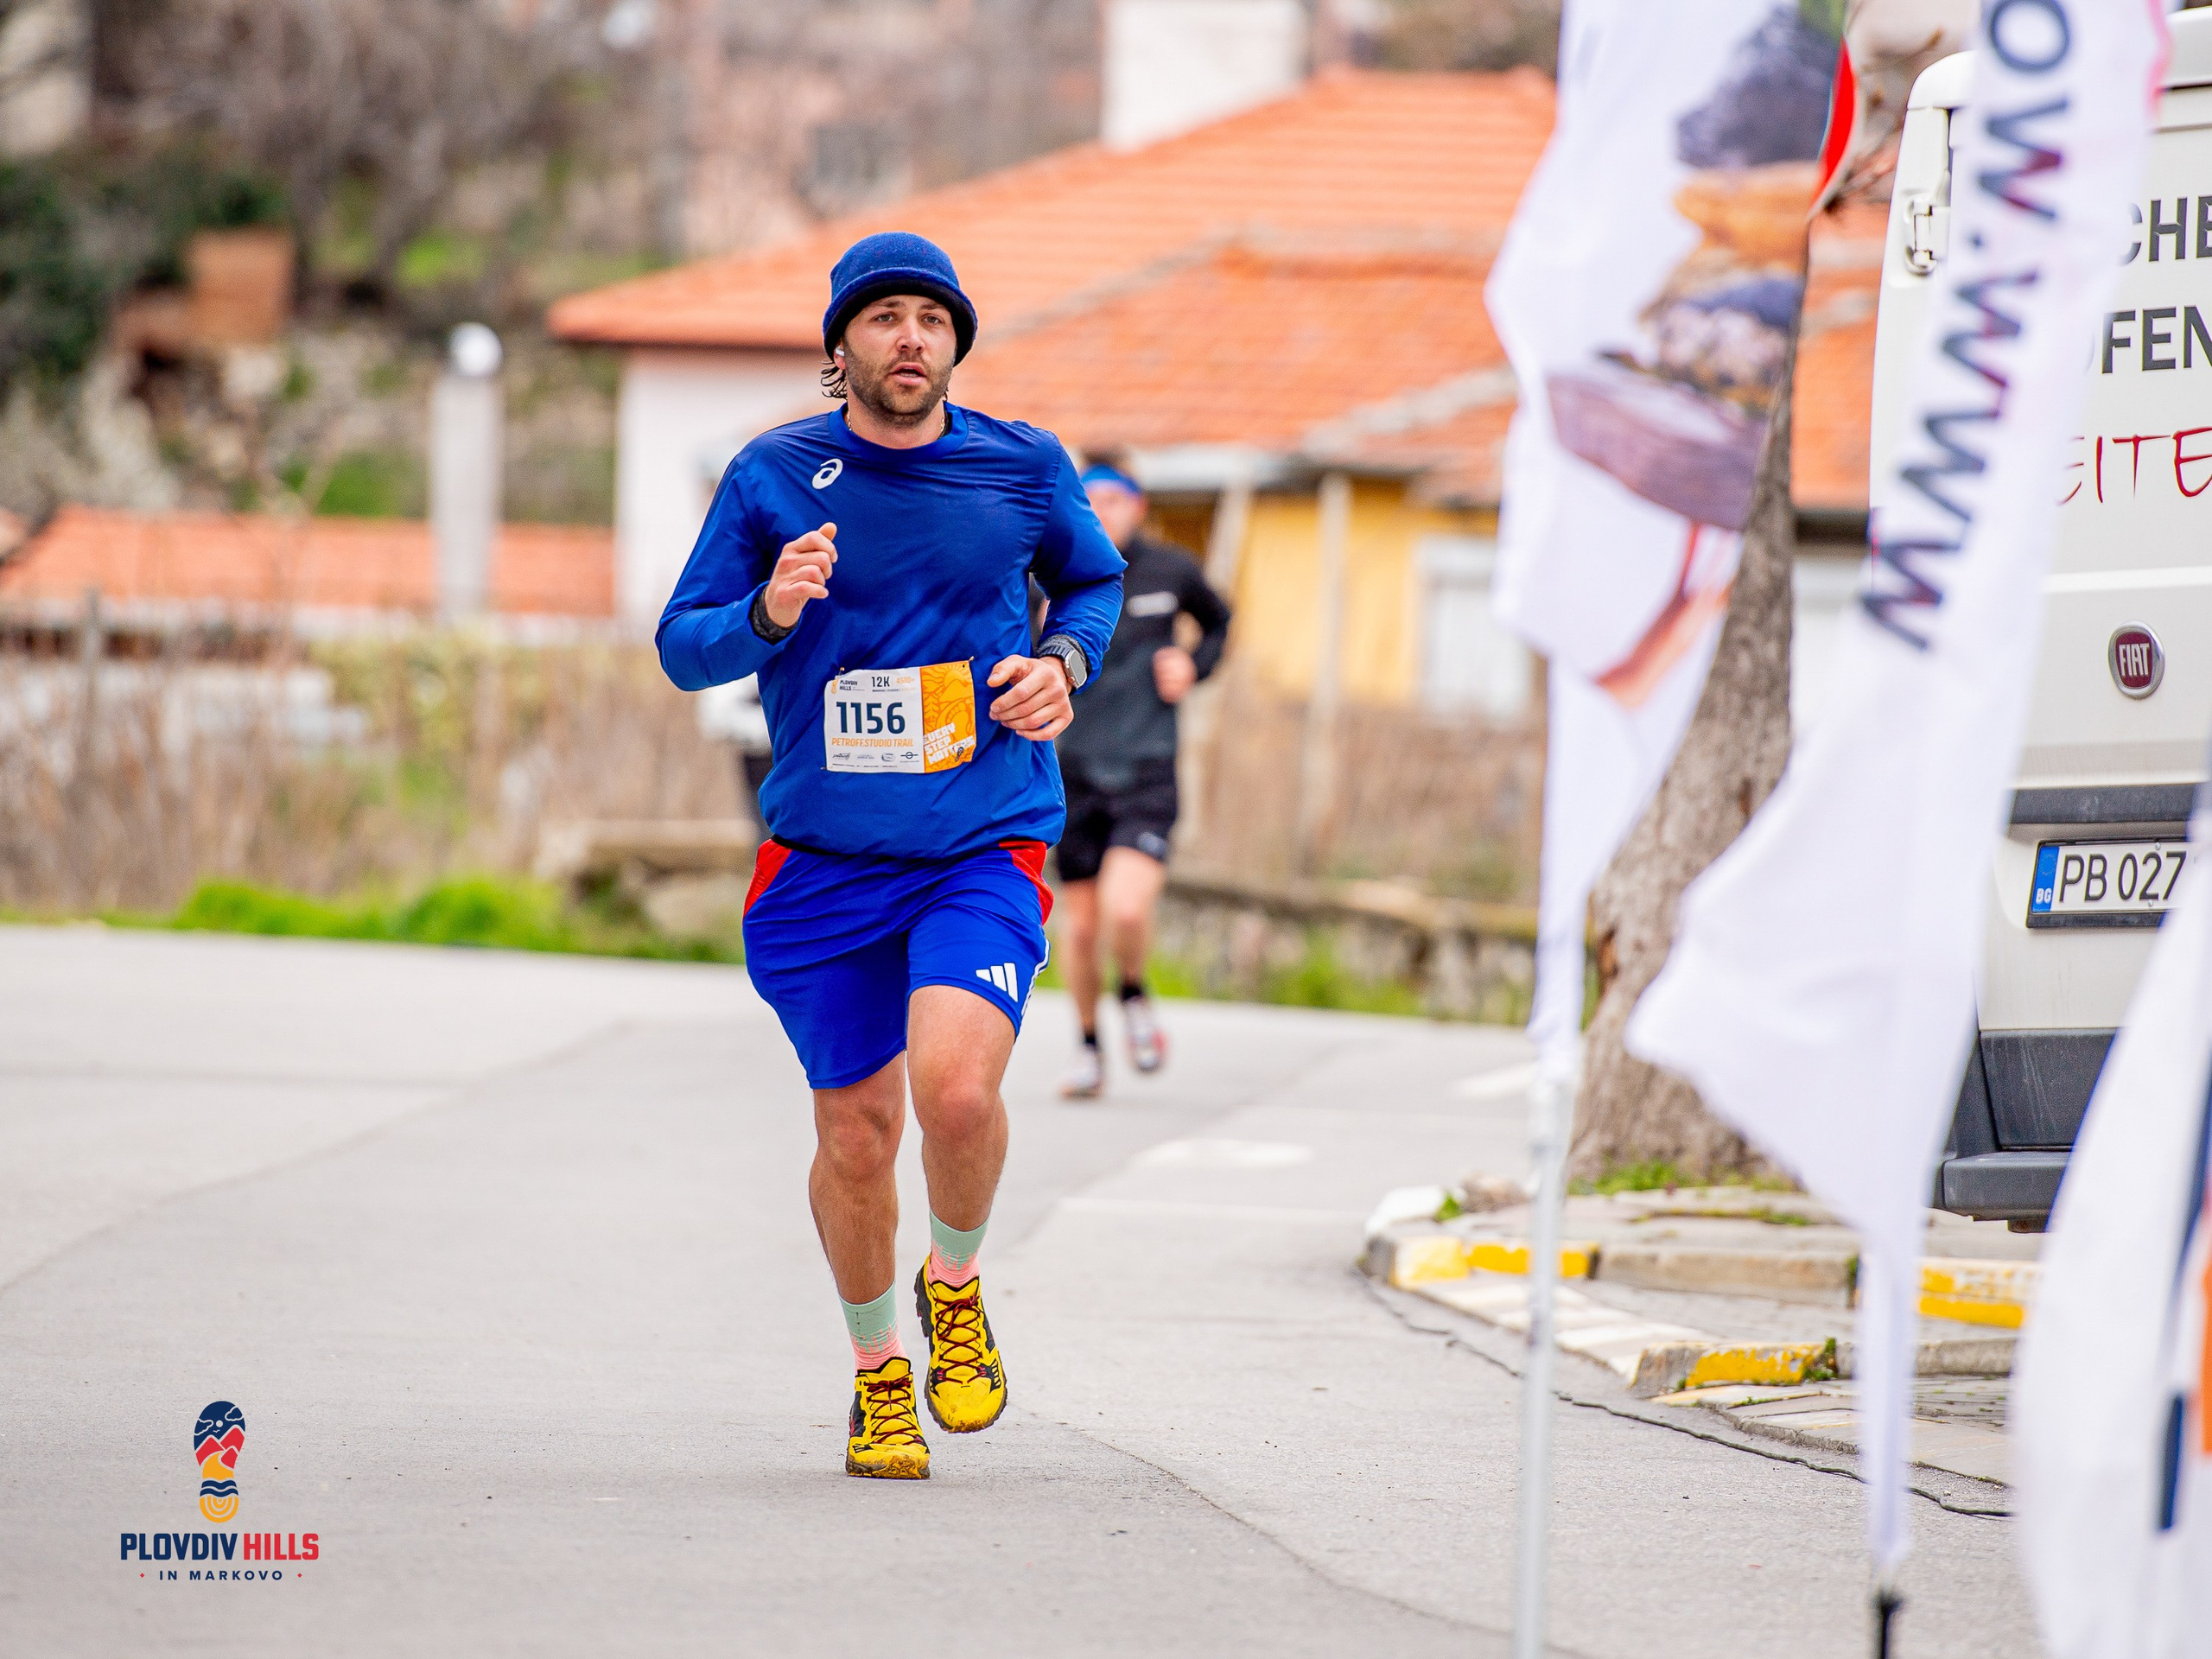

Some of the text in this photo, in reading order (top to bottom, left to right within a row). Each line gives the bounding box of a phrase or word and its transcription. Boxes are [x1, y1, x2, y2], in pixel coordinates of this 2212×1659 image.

[2119, 642, 2150, 677] FIAT
[872, 676, 890, 688] 12K
[836, 702, 906, 734] 1156
[893, 738, 914, 747] TRAIL
[924, 722, 956, 744] EVERY
[925, 735, 951, 754] STEP
[927, 735, 976, 764] MATTERS
[2059, 853, 2108, 903] PB
[2036, 887, 2052, 905] BG
